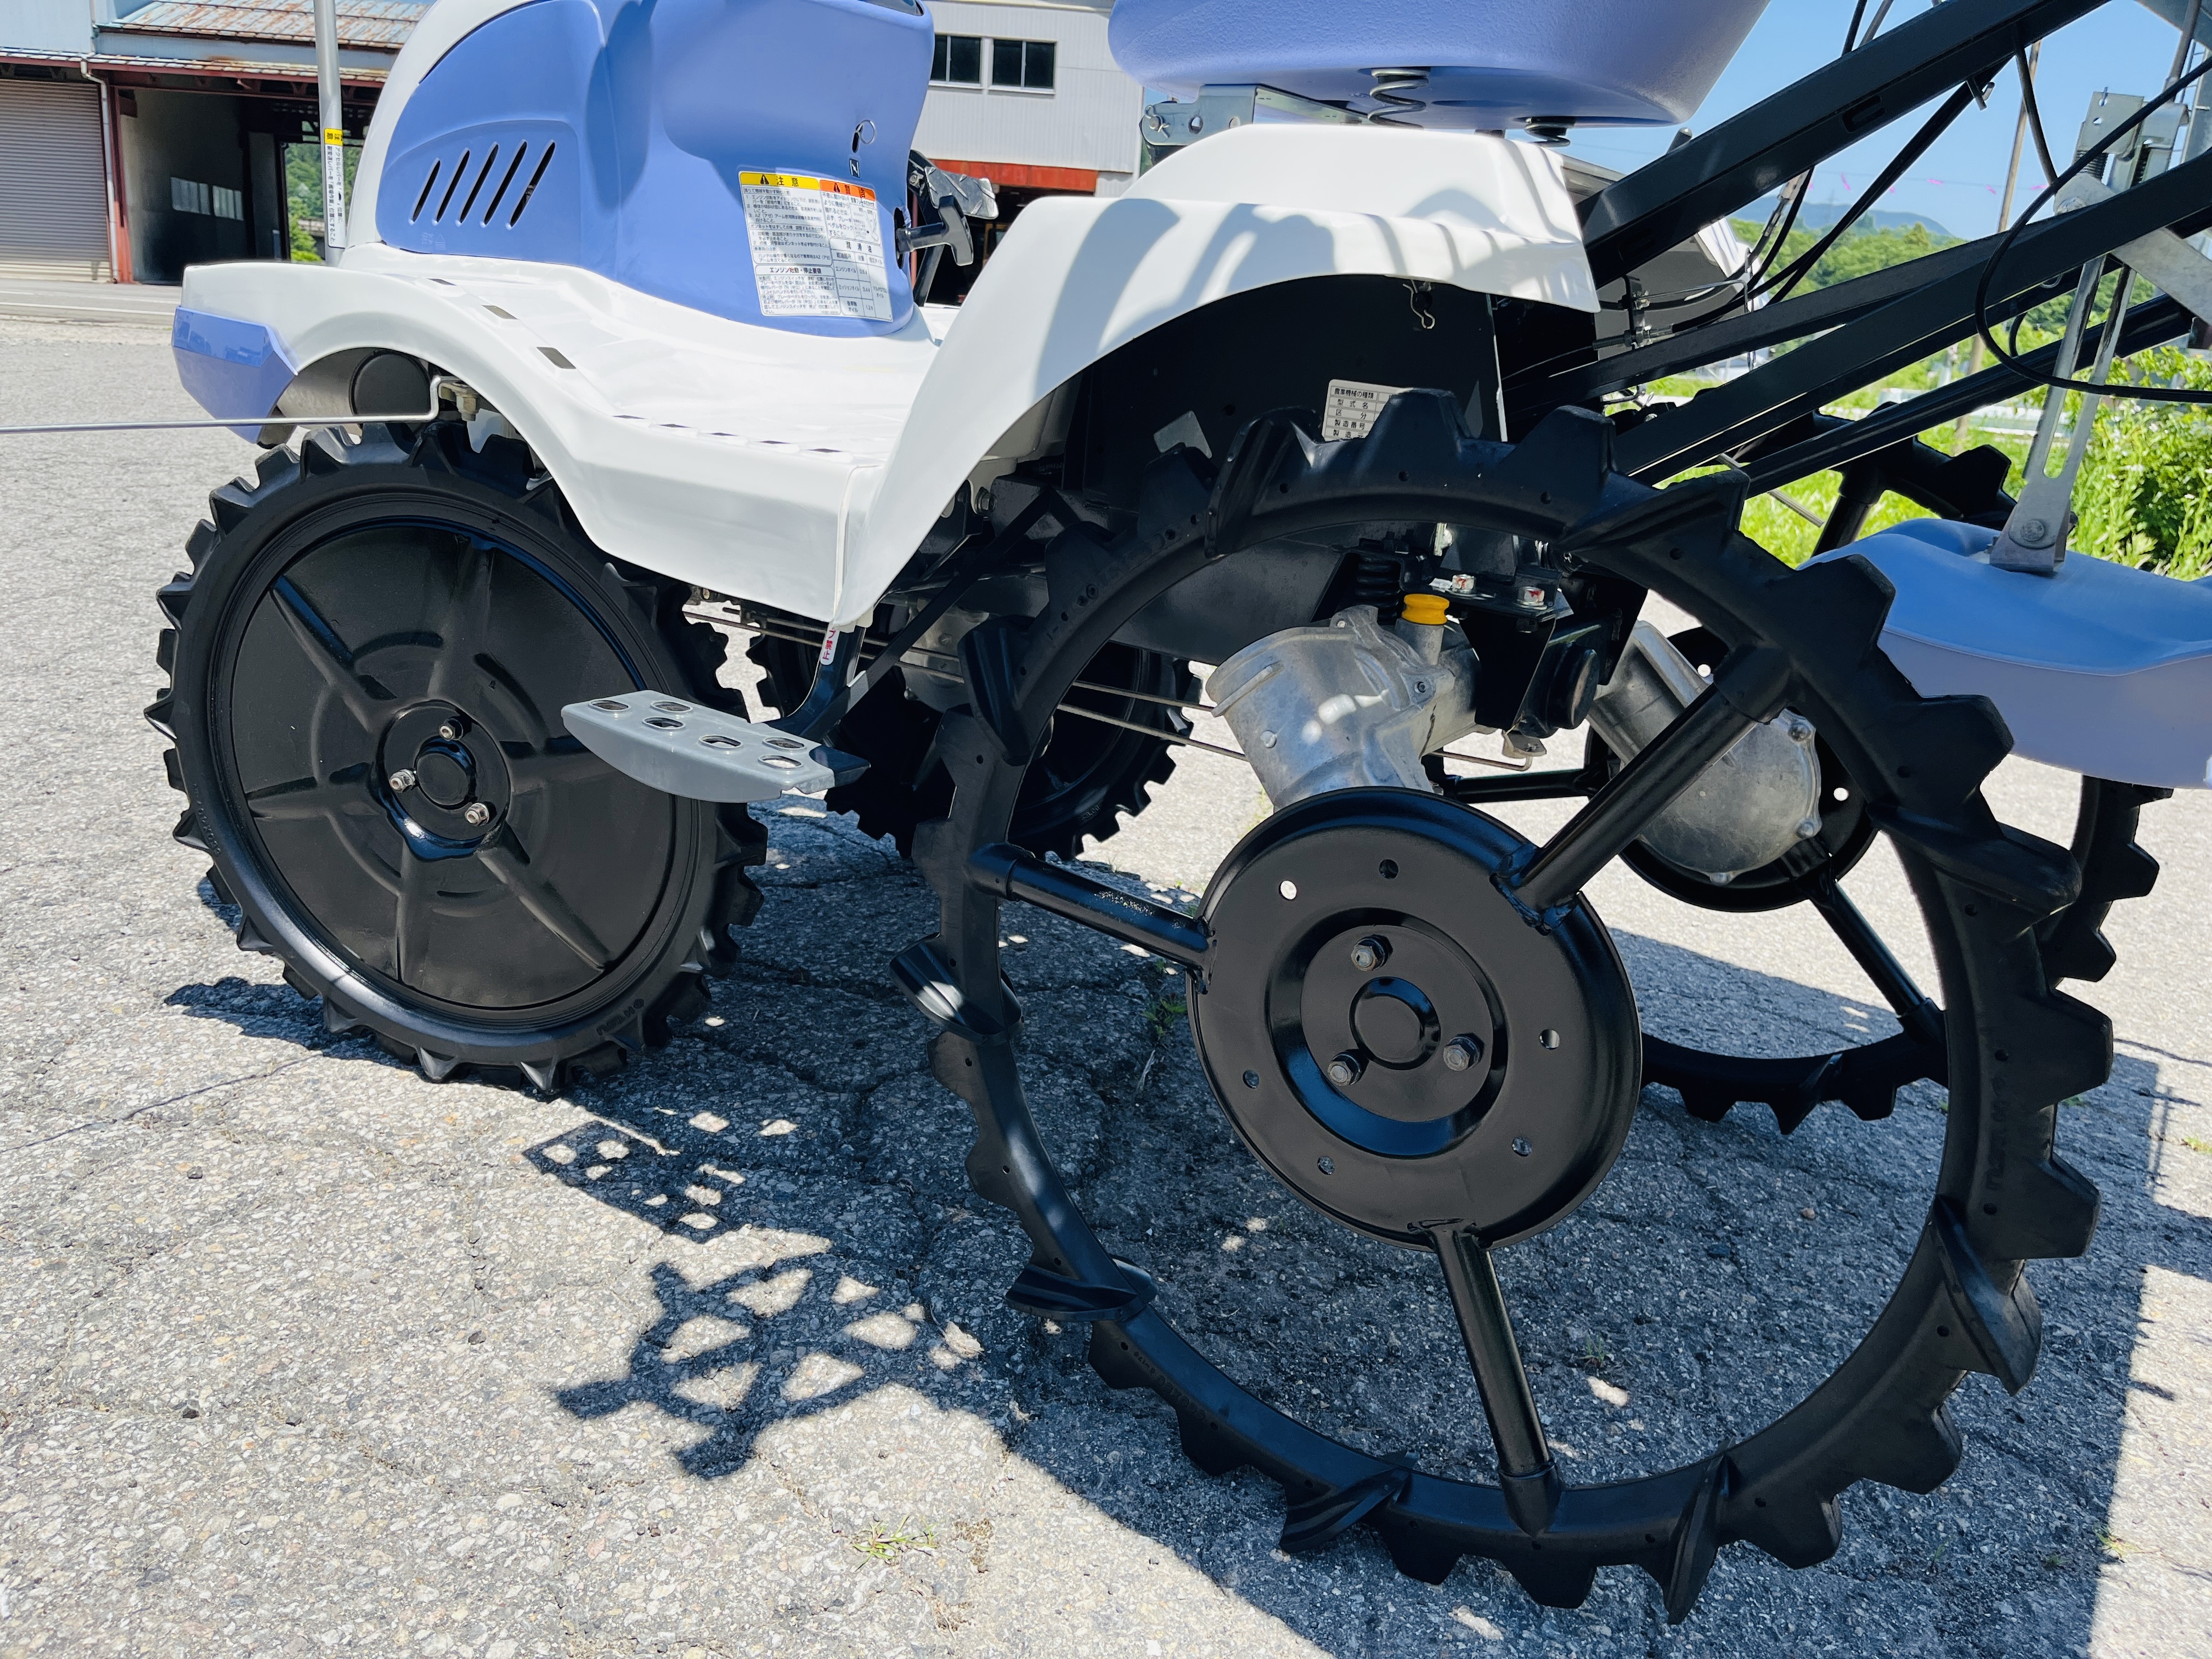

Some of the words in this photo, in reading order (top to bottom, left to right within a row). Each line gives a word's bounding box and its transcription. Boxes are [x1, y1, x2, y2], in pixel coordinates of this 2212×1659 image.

[777, 176, 799, 187] 注意
[1334, 388, 1374, 399] 農業機械の種類
[1338, 399, 1368, 409] 型式名
[1336, 409, 1366, 420] 区分
[1335, 420, 1365, 430] 製造番号
